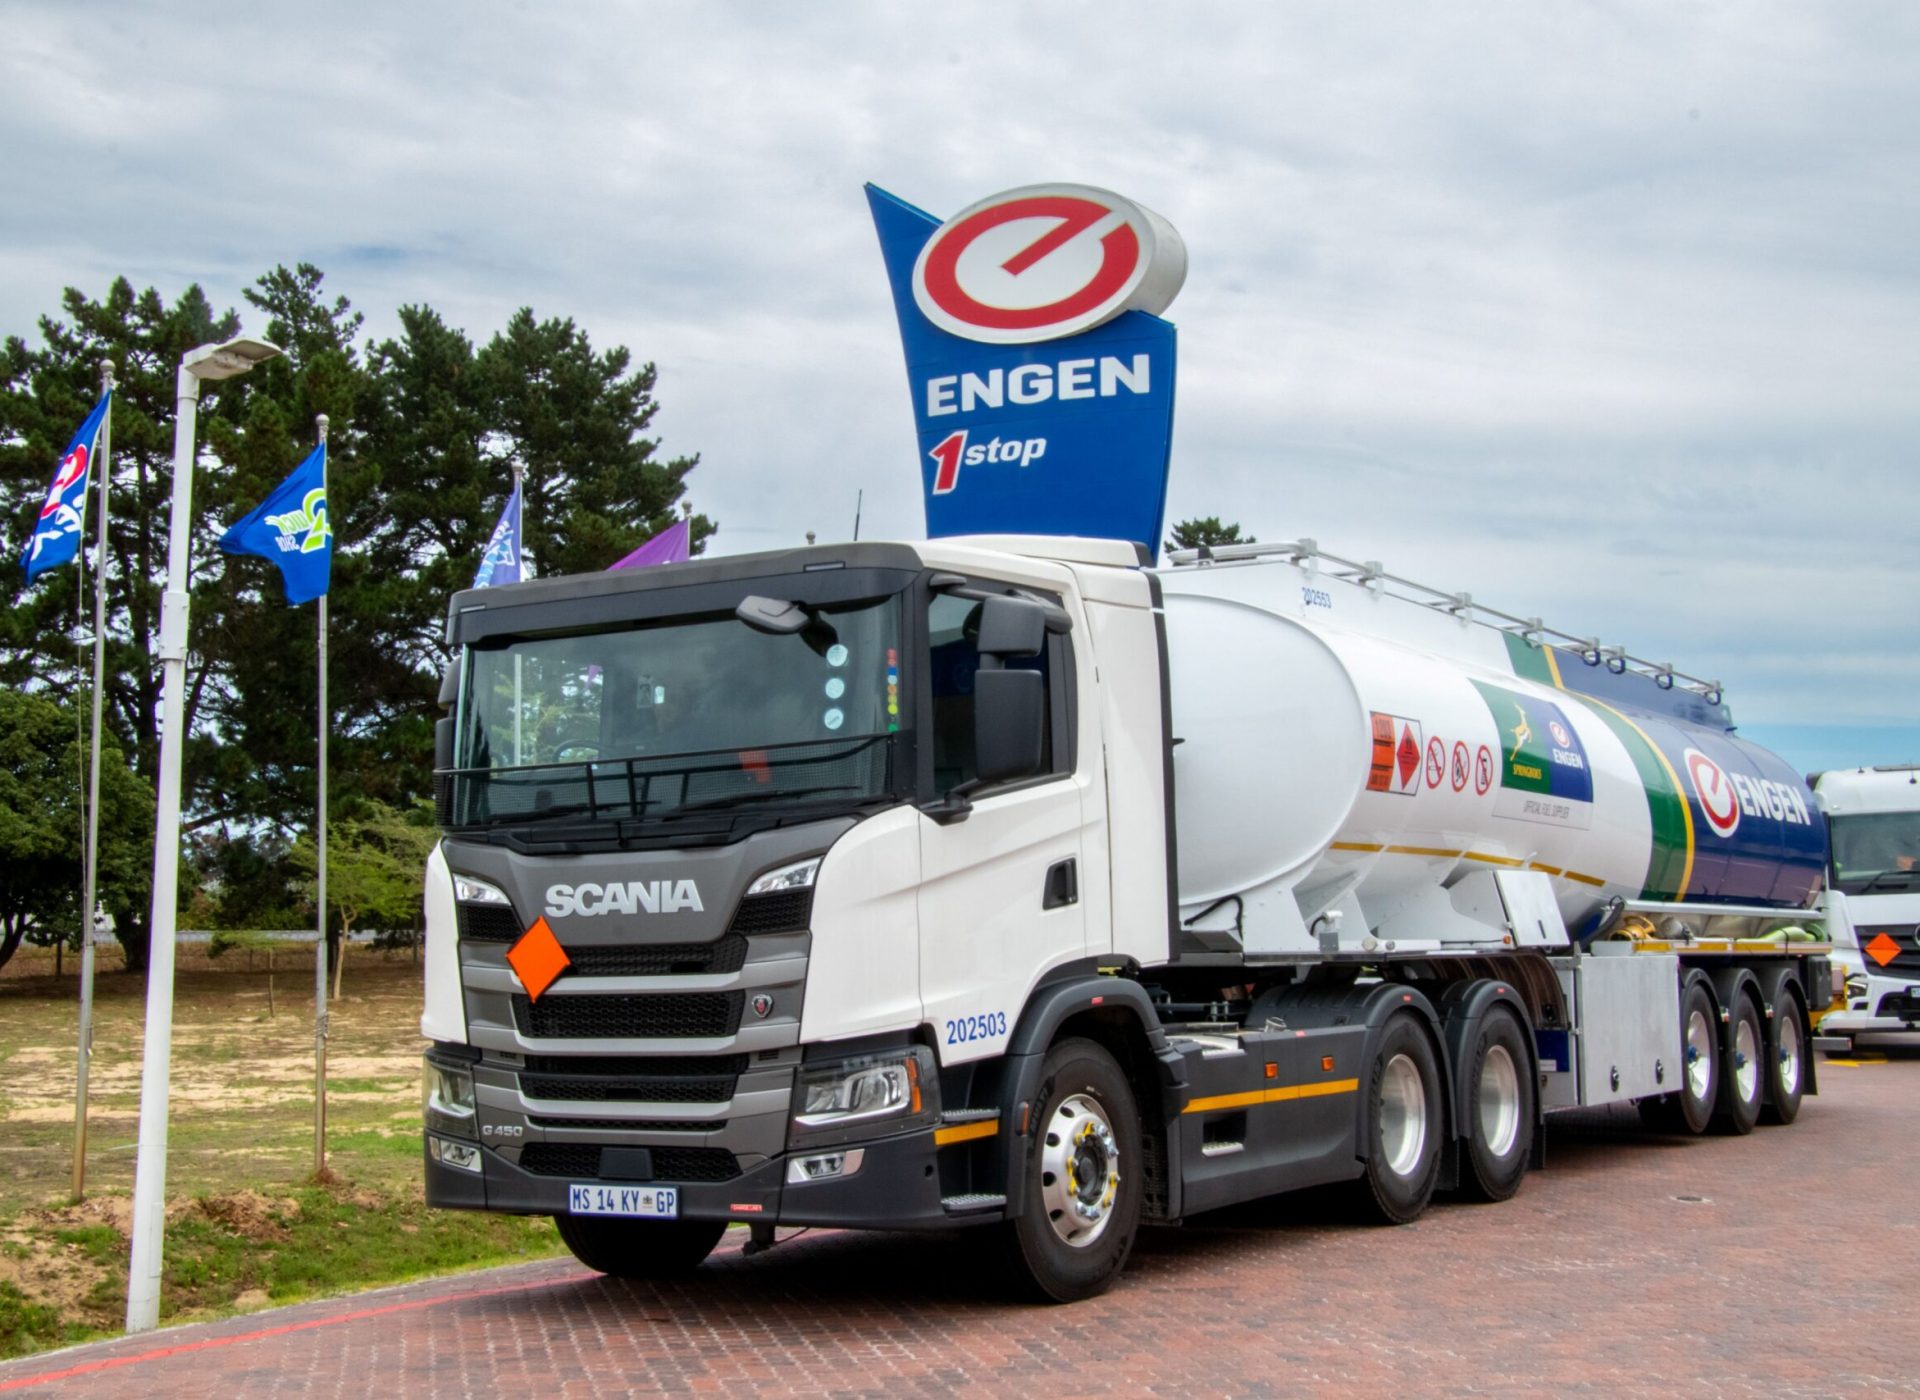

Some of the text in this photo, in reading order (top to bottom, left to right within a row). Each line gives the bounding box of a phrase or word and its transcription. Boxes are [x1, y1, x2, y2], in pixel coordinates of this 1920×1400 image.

[927, 353, 1150, 417] ENGEN
[1552, 748, 1584, 770] ENGEN
[1729, 772, 1811, 826] ENGEN
[544, 879, 704, 917] SCANIA
[946, 1011, 1007, 1045] 202503
[482, 1125, 523, 1136] G 450
[572, 1188, 675, 1213] MS 14 KY GP
